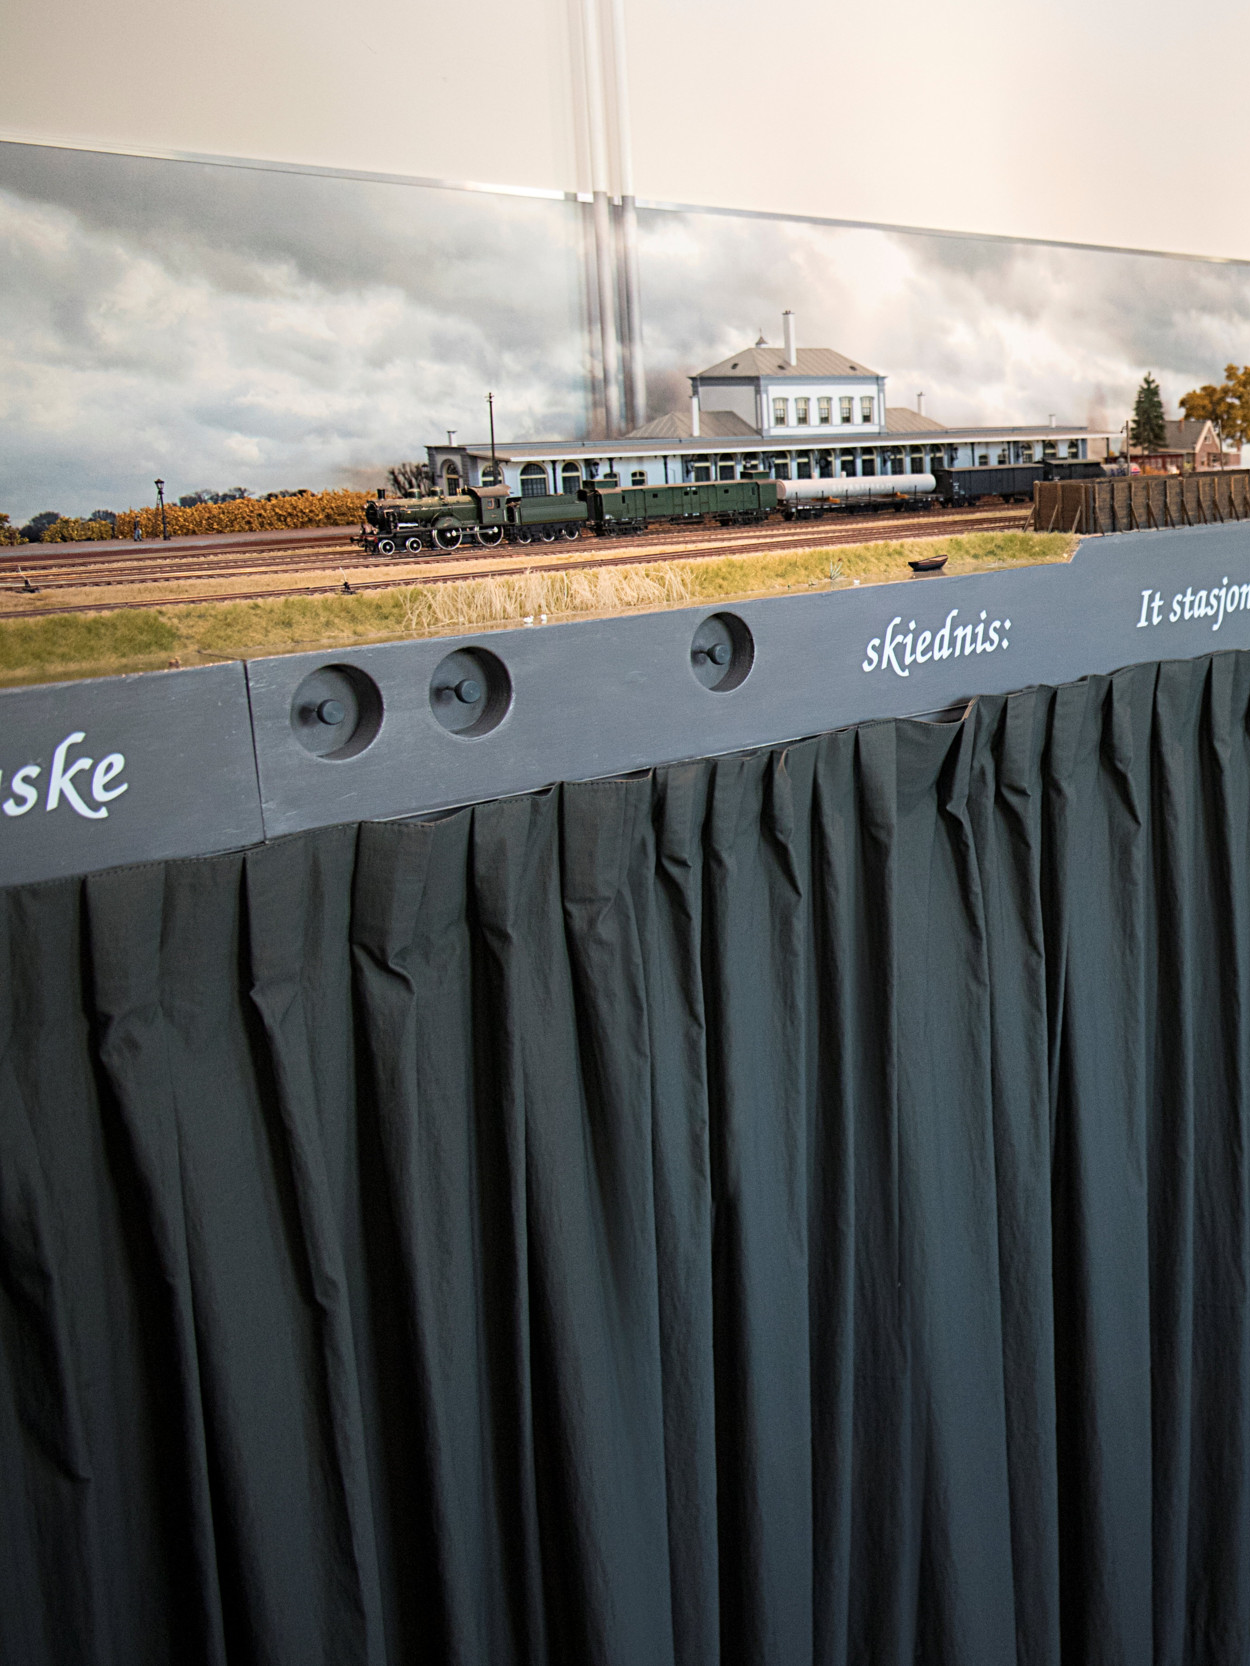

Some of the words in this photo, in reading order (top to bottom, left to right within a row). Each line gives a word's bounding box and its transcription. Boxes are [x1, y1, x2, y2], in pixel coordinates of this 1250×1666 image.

[1136, 589, 1165, 628] It
[861, 609, 1012, 677] skiednis:
[0, 731, 129, 819] ske
